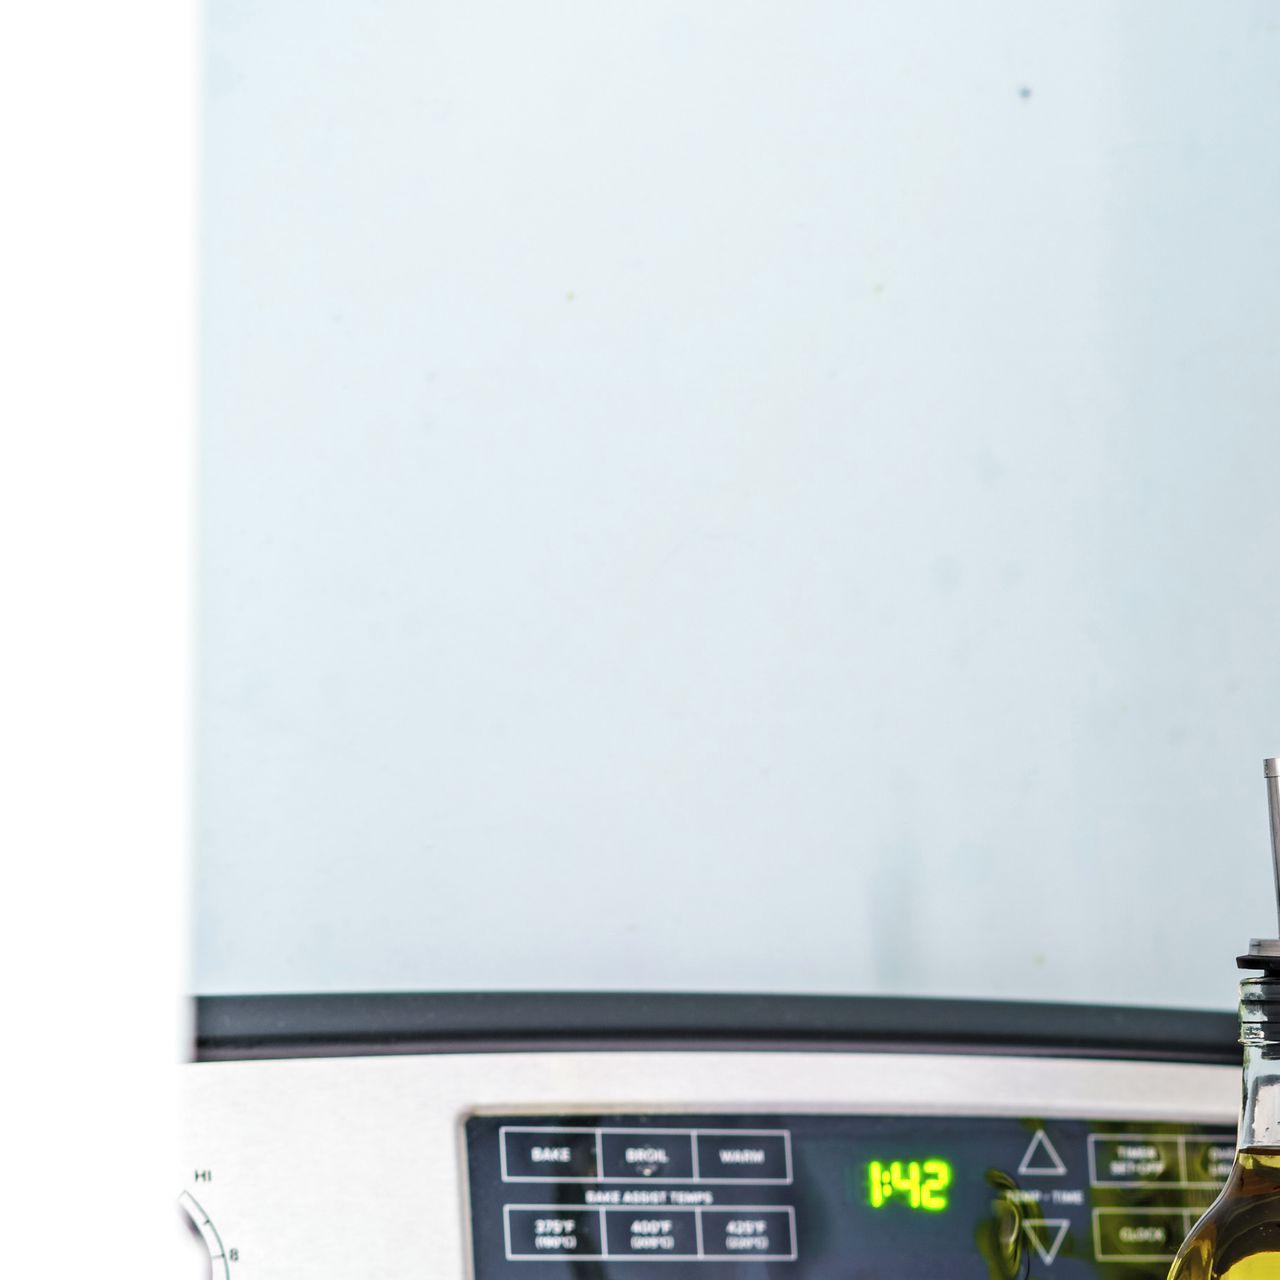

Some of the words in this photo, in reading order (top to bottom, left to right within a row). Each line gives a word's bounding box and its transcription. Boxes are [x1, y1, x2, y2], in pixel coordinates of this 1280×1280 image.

[531, 1146, 571, 1162] BAKE
[625, 1148, 669, 1163] BROIL
[718, 1149, 765, 1164] WARM
[194, 1170, 212, 1183] HI
[869, 1160, 950, 1210] 1:42
[585, 1190, 620, 1204] BAKE
[229, 1248, 239, 1262] 8
